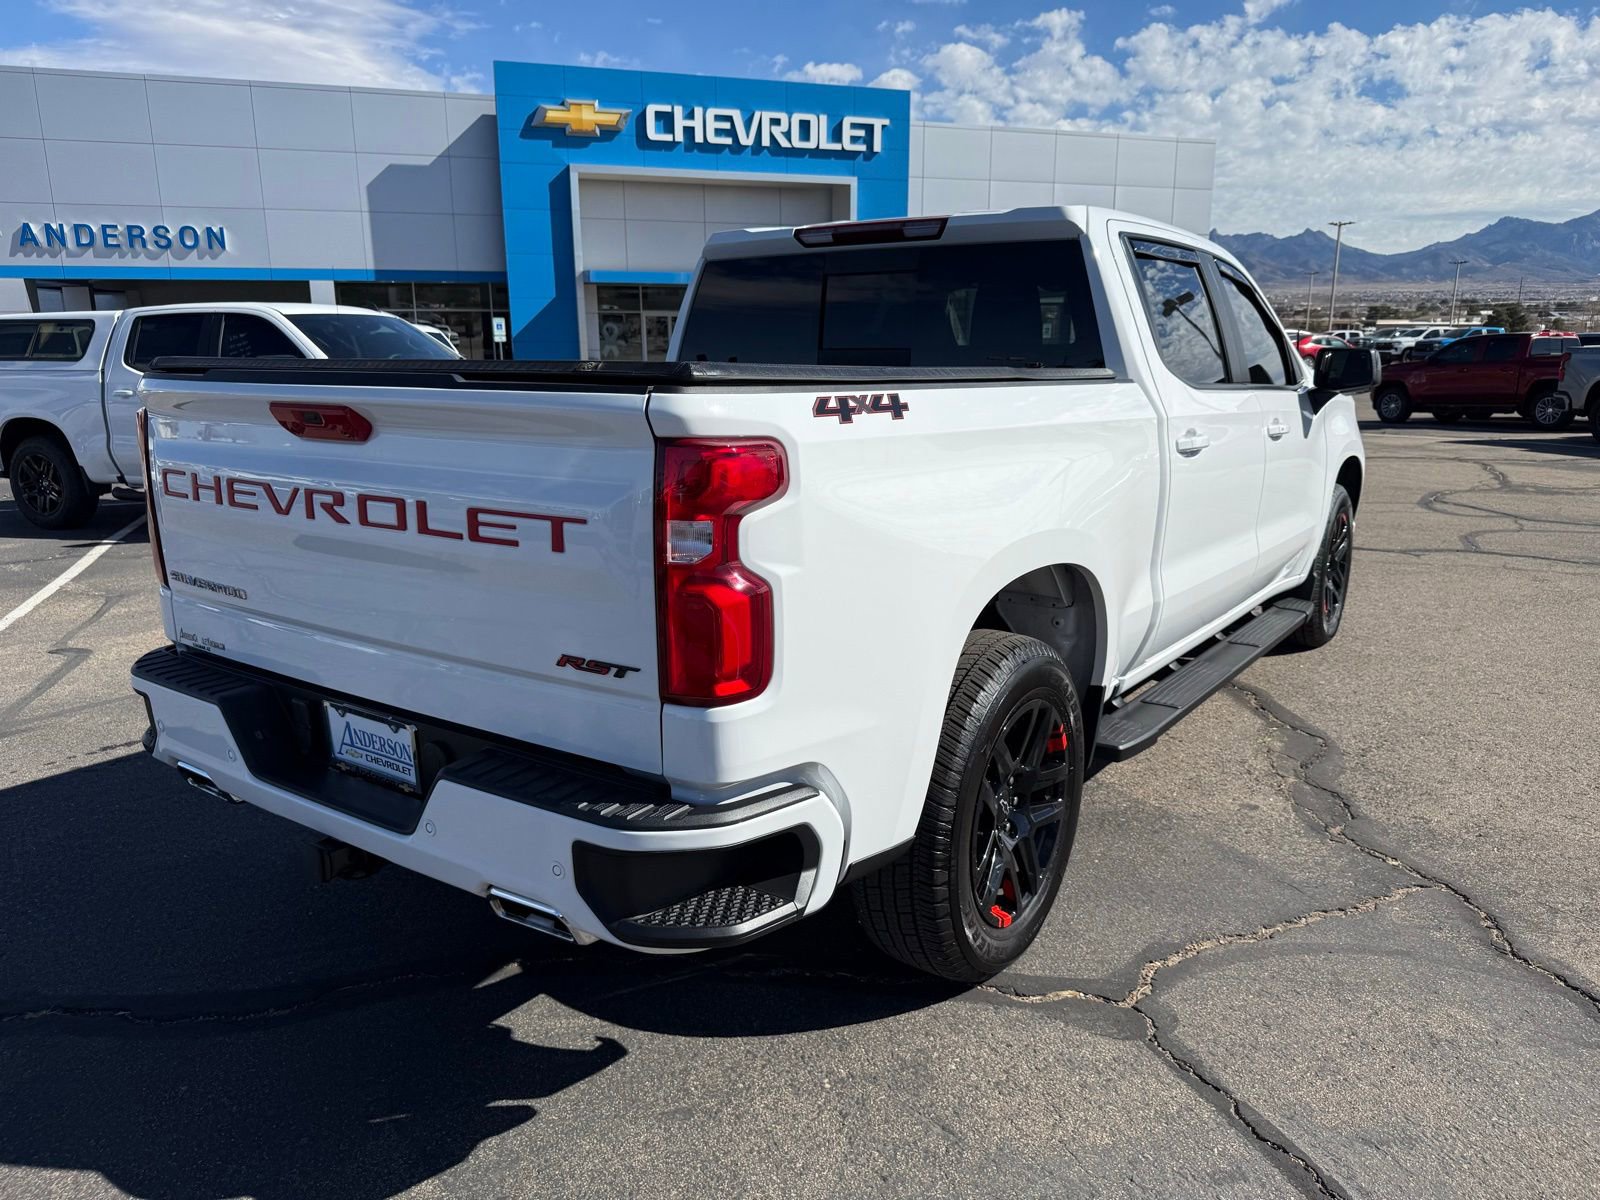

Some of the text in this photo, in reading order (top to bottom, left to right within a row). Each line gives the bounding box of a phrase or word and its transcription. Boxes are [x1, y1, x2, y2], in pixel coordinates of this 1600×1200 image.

[645, 104, 891, 153] CHEVROLET
[19, 222, 228, 251] ANDERSON
[161, 467, 589, 554] CHEVROLET
[555, 653, 642, 679] RST
[336, 720, 413, 763] ANDERSON
[364, 753, 412, 777] CHEVROLET
